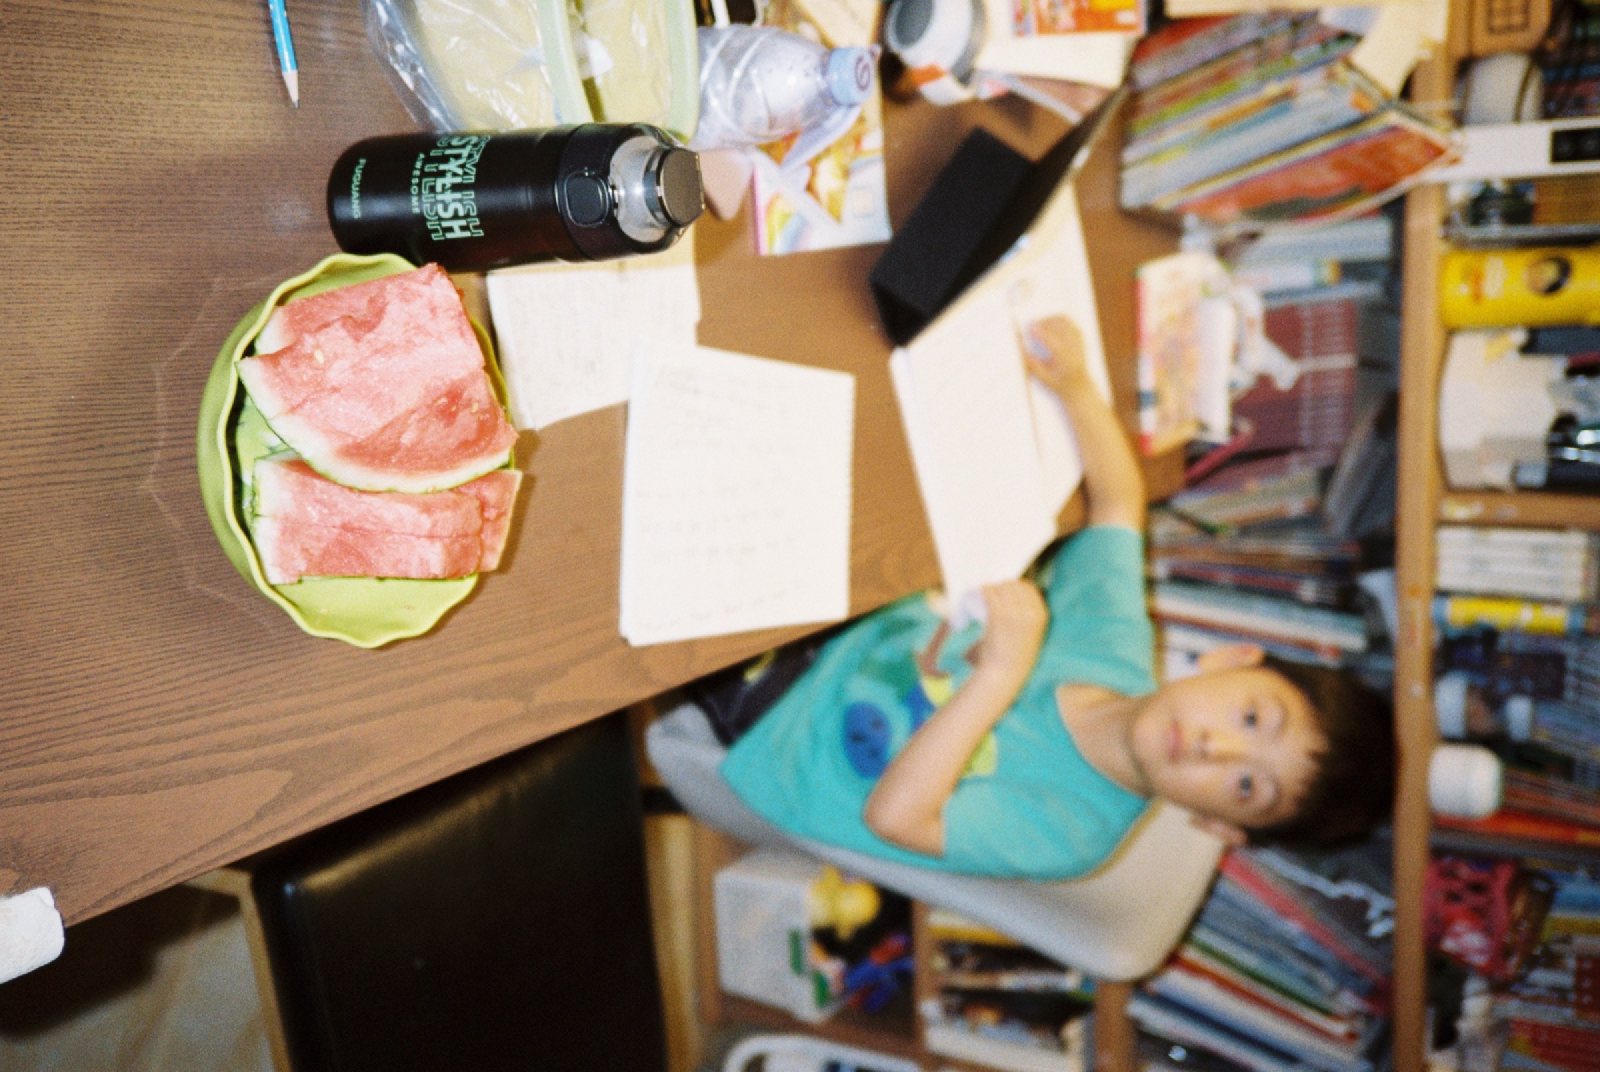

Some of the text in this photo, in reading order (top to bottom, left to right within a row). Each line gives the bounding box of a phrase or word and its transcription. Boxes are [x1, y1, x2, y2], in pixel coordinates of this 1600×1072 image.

[351, 158, 367, 218] FUGUANG
[411, 153, 425, 214] AWESOME
[435, 136, 479, 239] STYLISH
